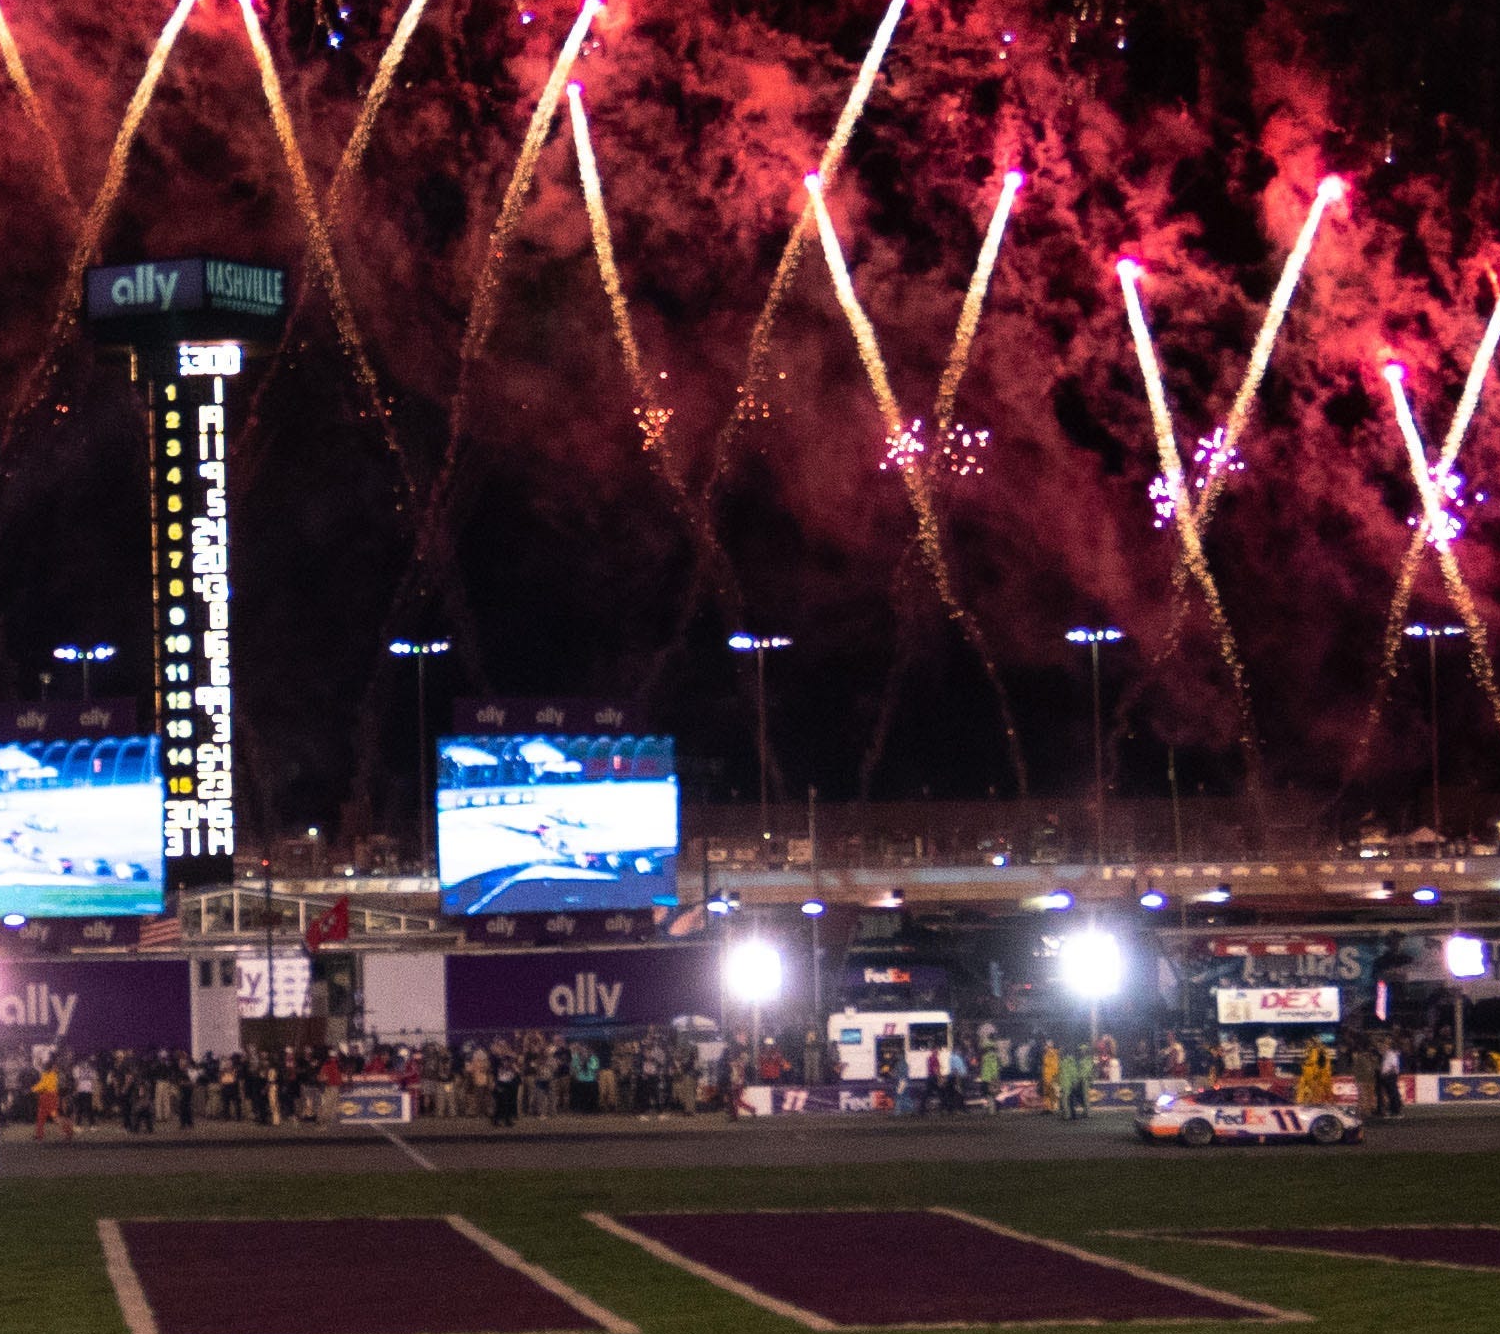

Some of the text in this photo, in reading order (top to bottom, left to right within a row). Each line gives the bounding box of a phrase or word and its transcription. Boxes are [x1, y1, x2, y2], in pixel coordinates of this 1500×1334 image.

[111, 263, 180, 312] ally
[205, 260, 285, 306] NASHVILLE
[165, 376, 224, 404] 1 1
[165, 411, 181, 429] 2
[166, 439, 182, 457] 3
[167, 467, 182, 484] 4
[168, 551, 184, 569] 7
[165, 635, 192, 653] 10
[165, 663, 190, 682] 11
[166, 691, 192, 710] 12
[16, 710, 47, 732] ally
[79, 707, 111, 730] ally
[166, 713, 231, 742] 13 3
[476, 705, 623, 728] ally ally ally
[167, 748, 193, 766] 14
[169, 771, 232, 799] 15 23
[164, 800, 199, 829] 30
[164, 828, 200, 856] 31
[82, 920, 115, 942] ally
[486, 914, 635, 938] ally ally ally
[548, 972, 624, 1018] ally
[1260, 991, 1322, 1010] DEX
[1215, 1109, 1304, 1131] FedEx 11
